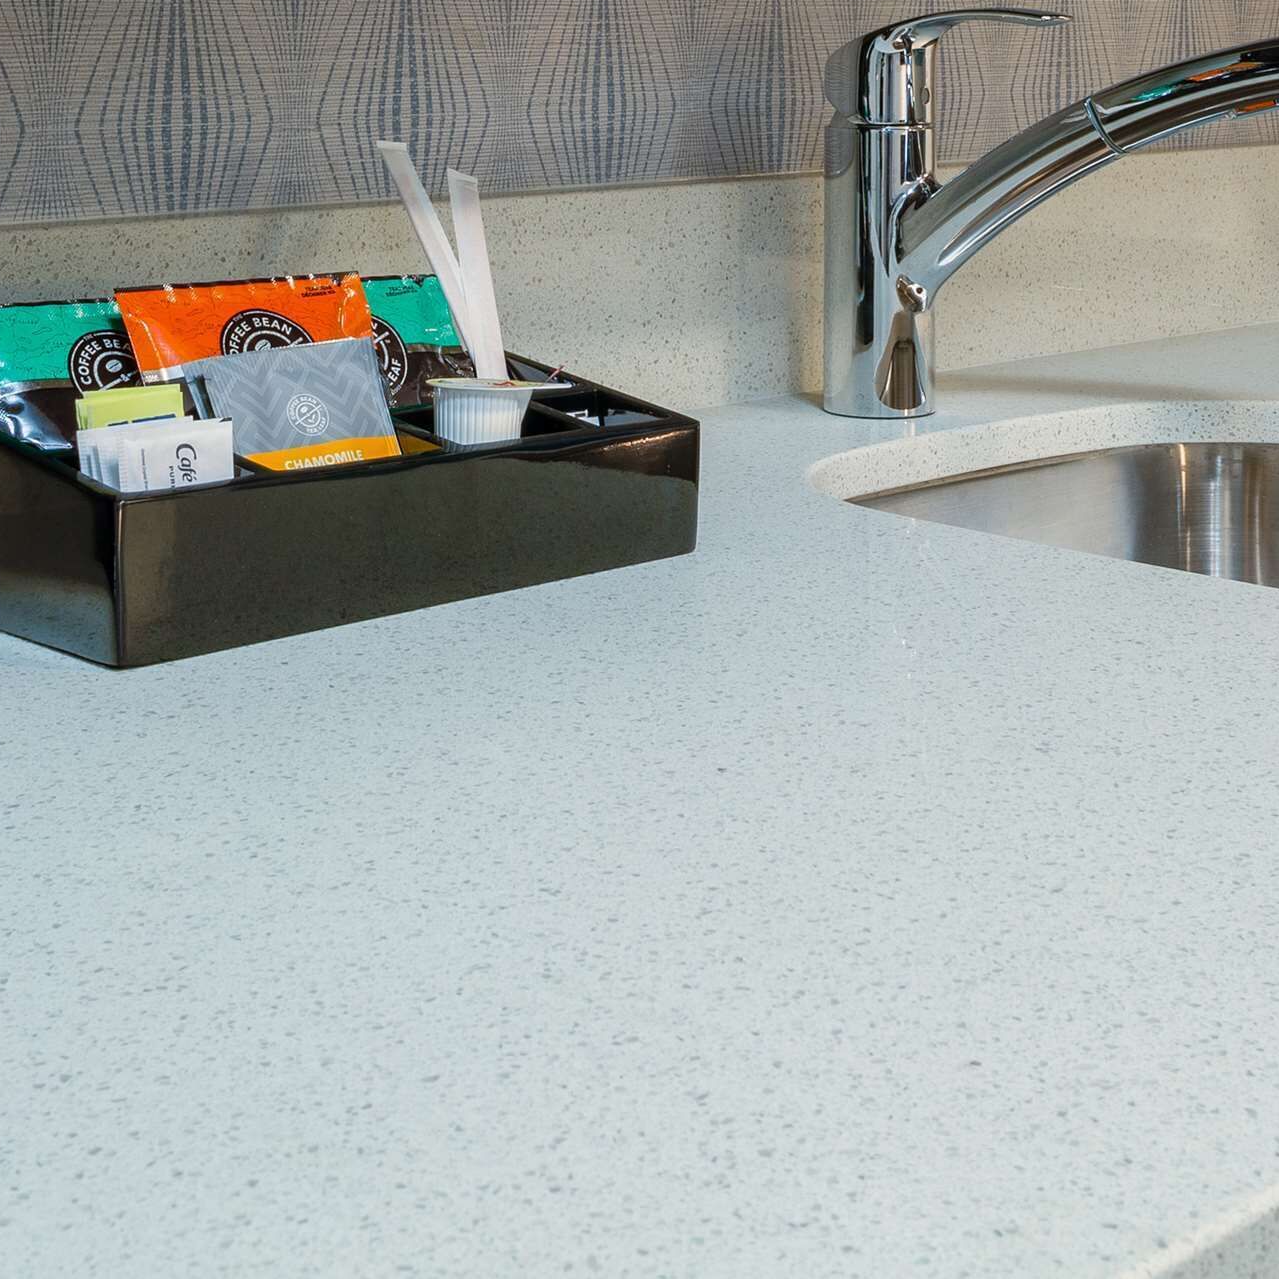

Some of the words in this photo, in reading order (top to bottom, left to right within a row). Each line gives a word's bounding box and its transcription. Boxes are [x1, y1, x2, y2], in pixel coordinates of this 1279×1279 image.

[252, 317, 292, 335] BEAN
[78, 341, 102, 385] COFFEE
[103, 338, 133, 354] BEA
[176, 443, 197, 482] Café
[285, 450, 365, 471] CHAMOMILE
